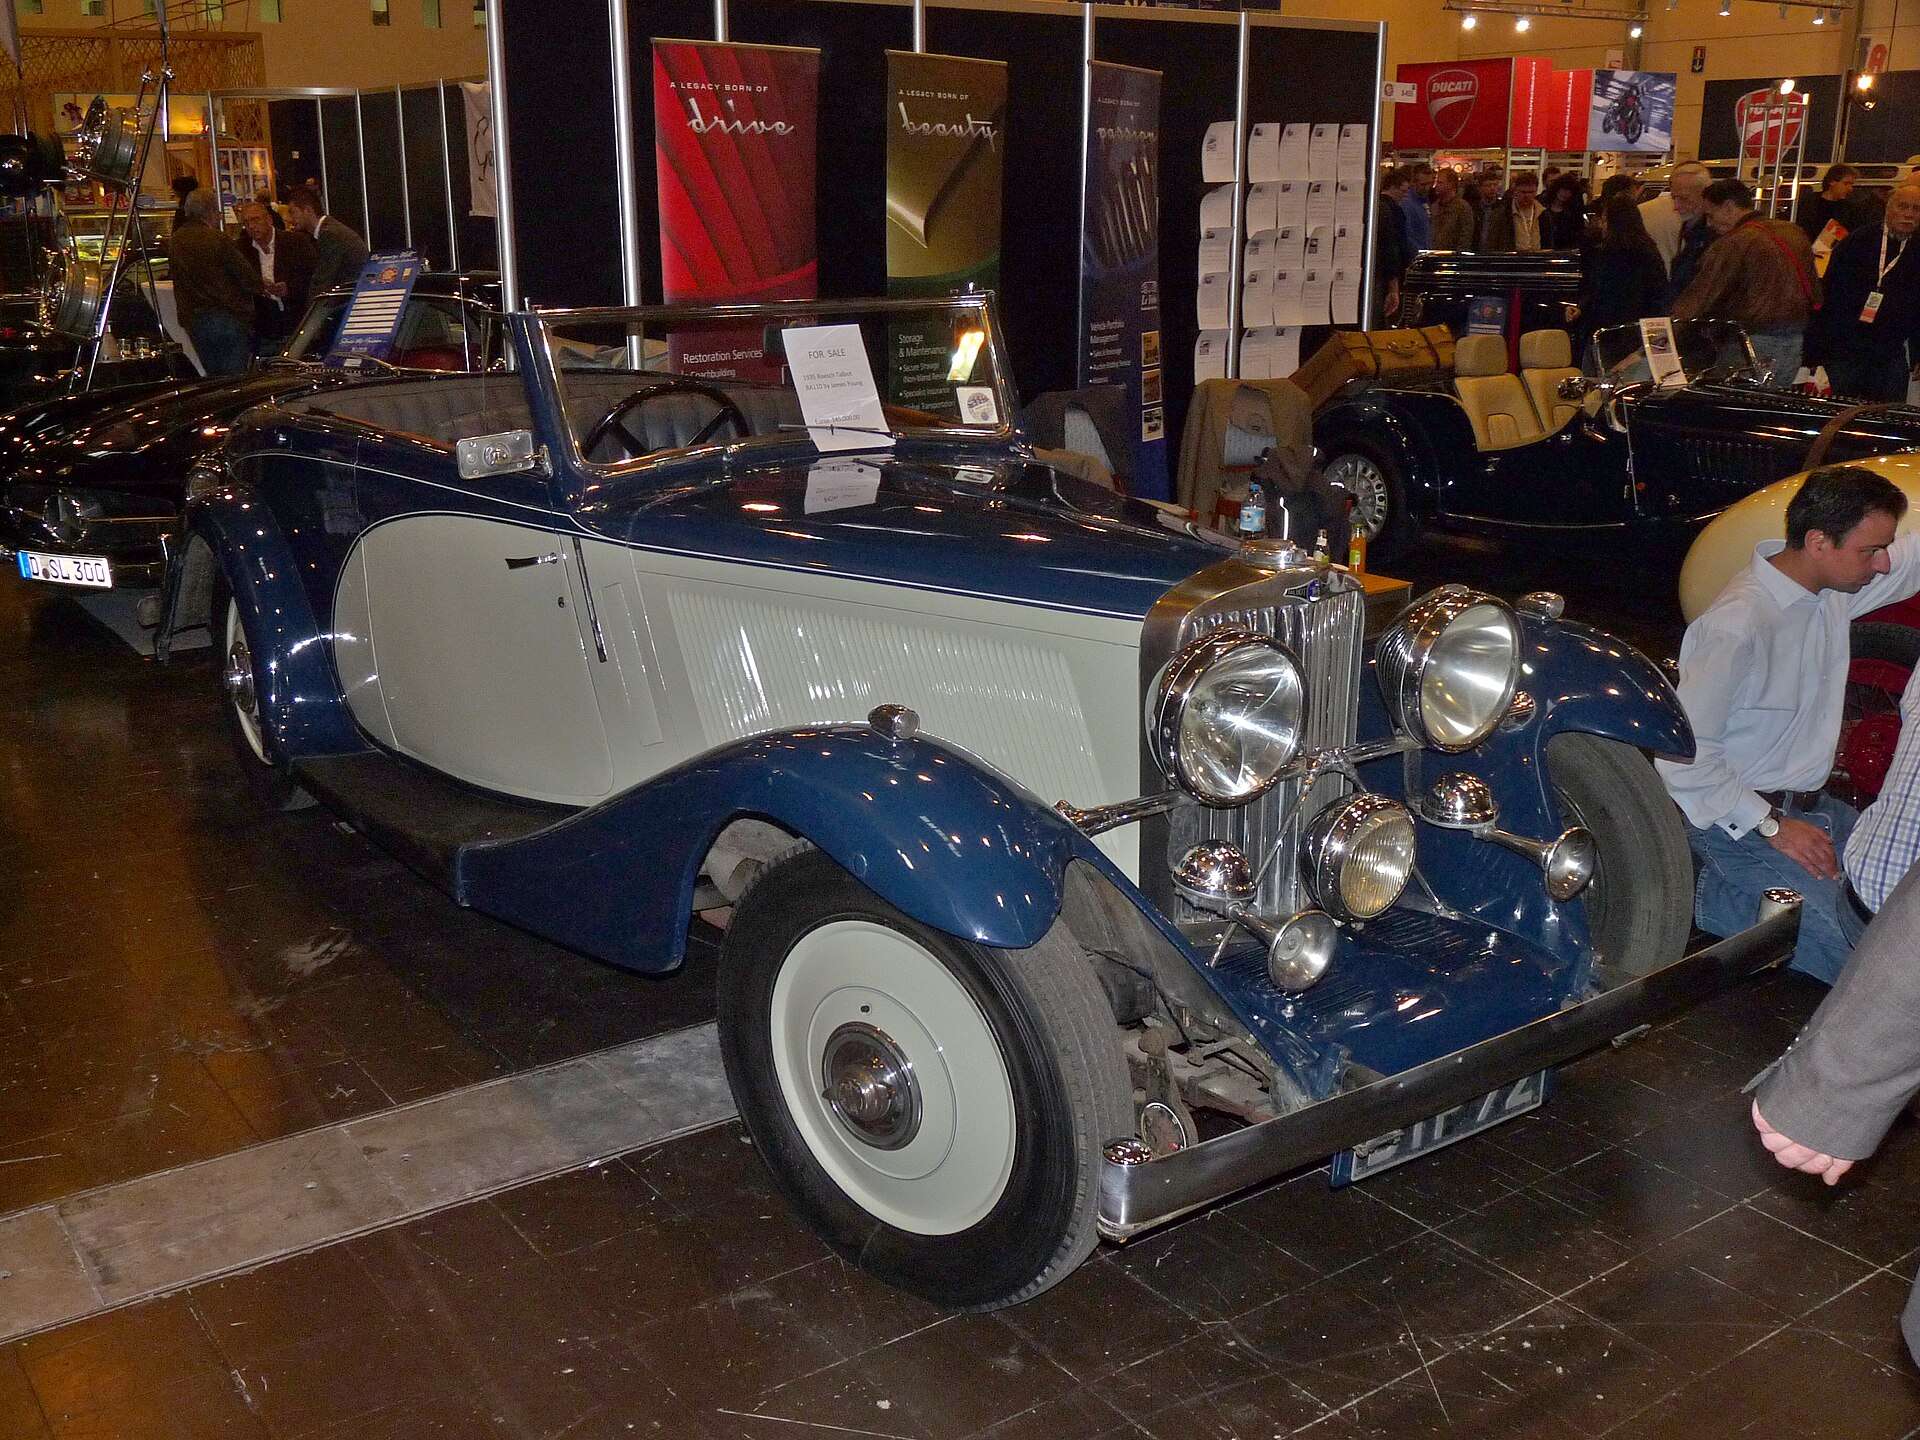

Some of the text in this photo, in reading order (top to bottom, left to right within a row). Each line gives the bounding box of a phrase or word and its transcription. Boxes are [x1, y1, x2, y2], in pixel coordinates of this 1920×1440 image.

[670, 81, 769, 93] A LEGACY BORN OF
[1431, 80, 1473, 93] DUCATI
[906, 90, 935, 98] LEGACY
[937, 92, 957, 100] BORN
[687, 97, 795, 136] drive
[898, 102, 998, 153] beauty
[898, 334, 924, 345] Storage
[683, 347, 763, 364] Restoration Services
[808, 348, 847, 359] FOR SALE
[899, 346, 947, 358] & Maintenance
[31, 556, 105, 581] D SL 300
